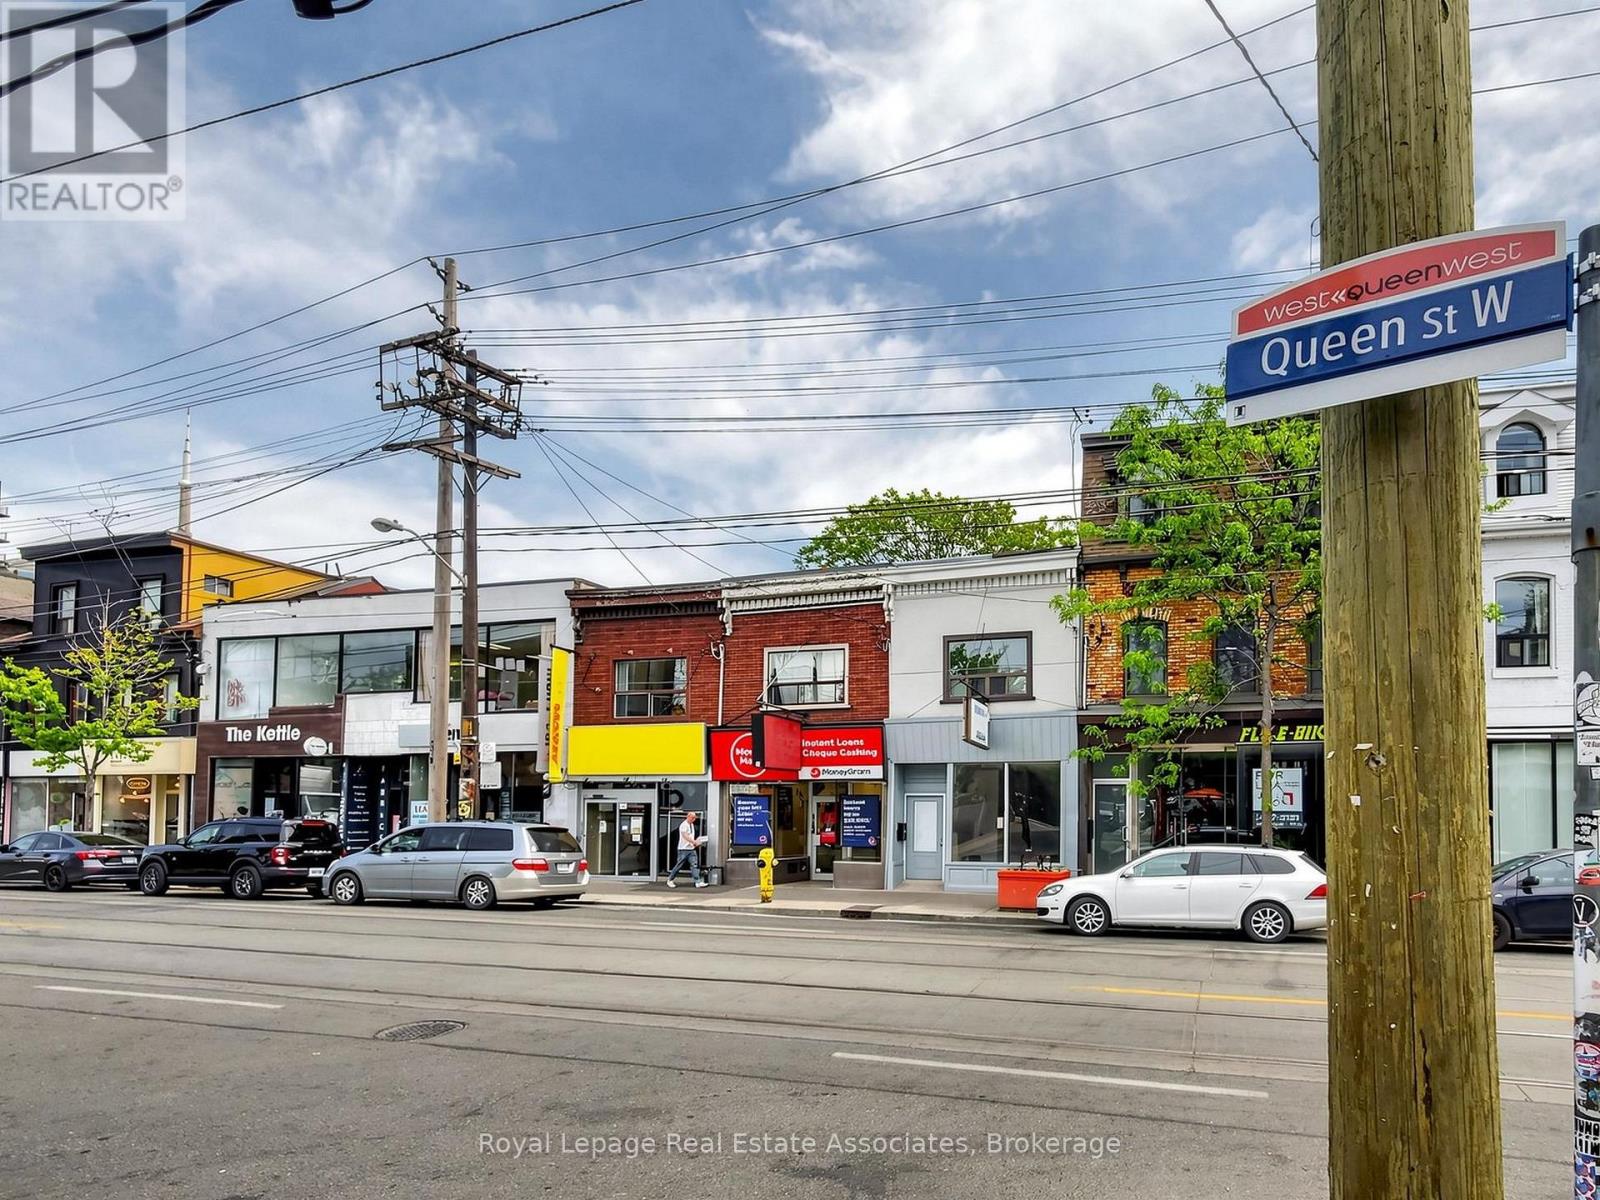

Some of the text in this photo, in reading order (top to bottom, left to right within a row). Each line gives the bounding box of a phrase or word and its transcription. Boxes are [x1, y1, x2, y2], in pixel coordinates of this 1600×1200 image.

[1261, 280, 1514, 377] Queen St W
[225, 724, 301, 742] The Kettle
[1276, 725, 1325, 741] E-BIK
[801, 738, 865, 747] Instant Loans
[839, 748, 878, 758] Cashing
[821, 768, 871, 776] MoneyGram
